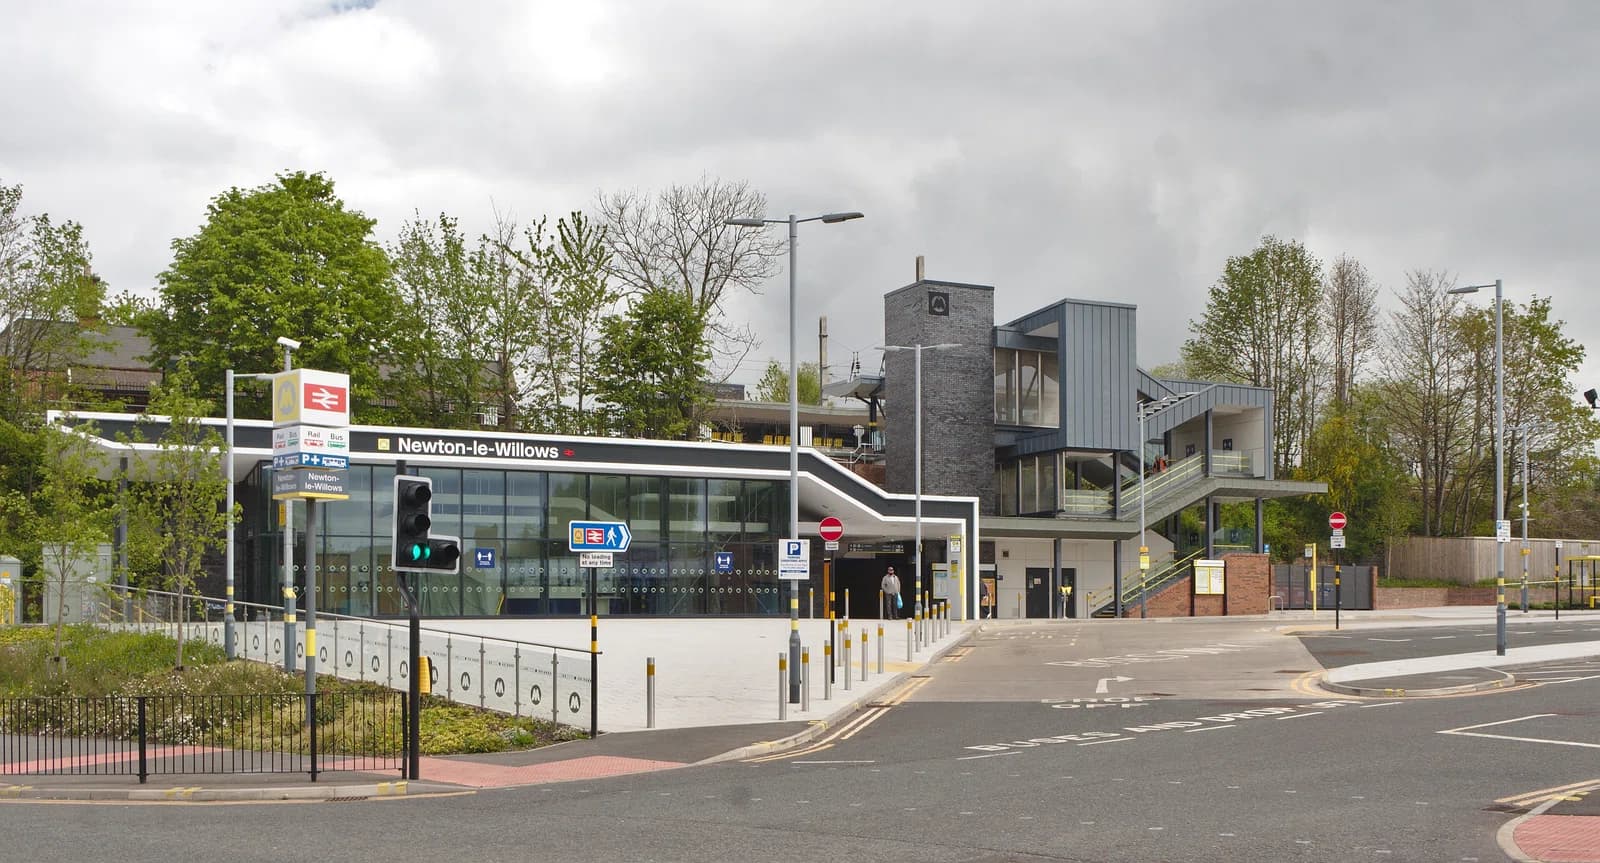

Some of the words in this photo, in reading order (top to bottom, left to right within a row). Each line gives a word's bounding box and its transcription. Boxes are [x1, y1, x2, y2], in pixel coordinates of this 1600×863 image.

[330, 433, 344, 441] Bus
[398, 437, 559, 459] Newton-le-Willows
[308, 472, 340, 482] Newton-
[304, 482, 343, 492] le-Willows
[789, 543, 799, 555] P
[591, 553, 611, 561] loading
[1041, 696, 1161, 704] DROP
[963, 731, 1121, 752] BUSES
[1123, 721, 1203, 733] AND
